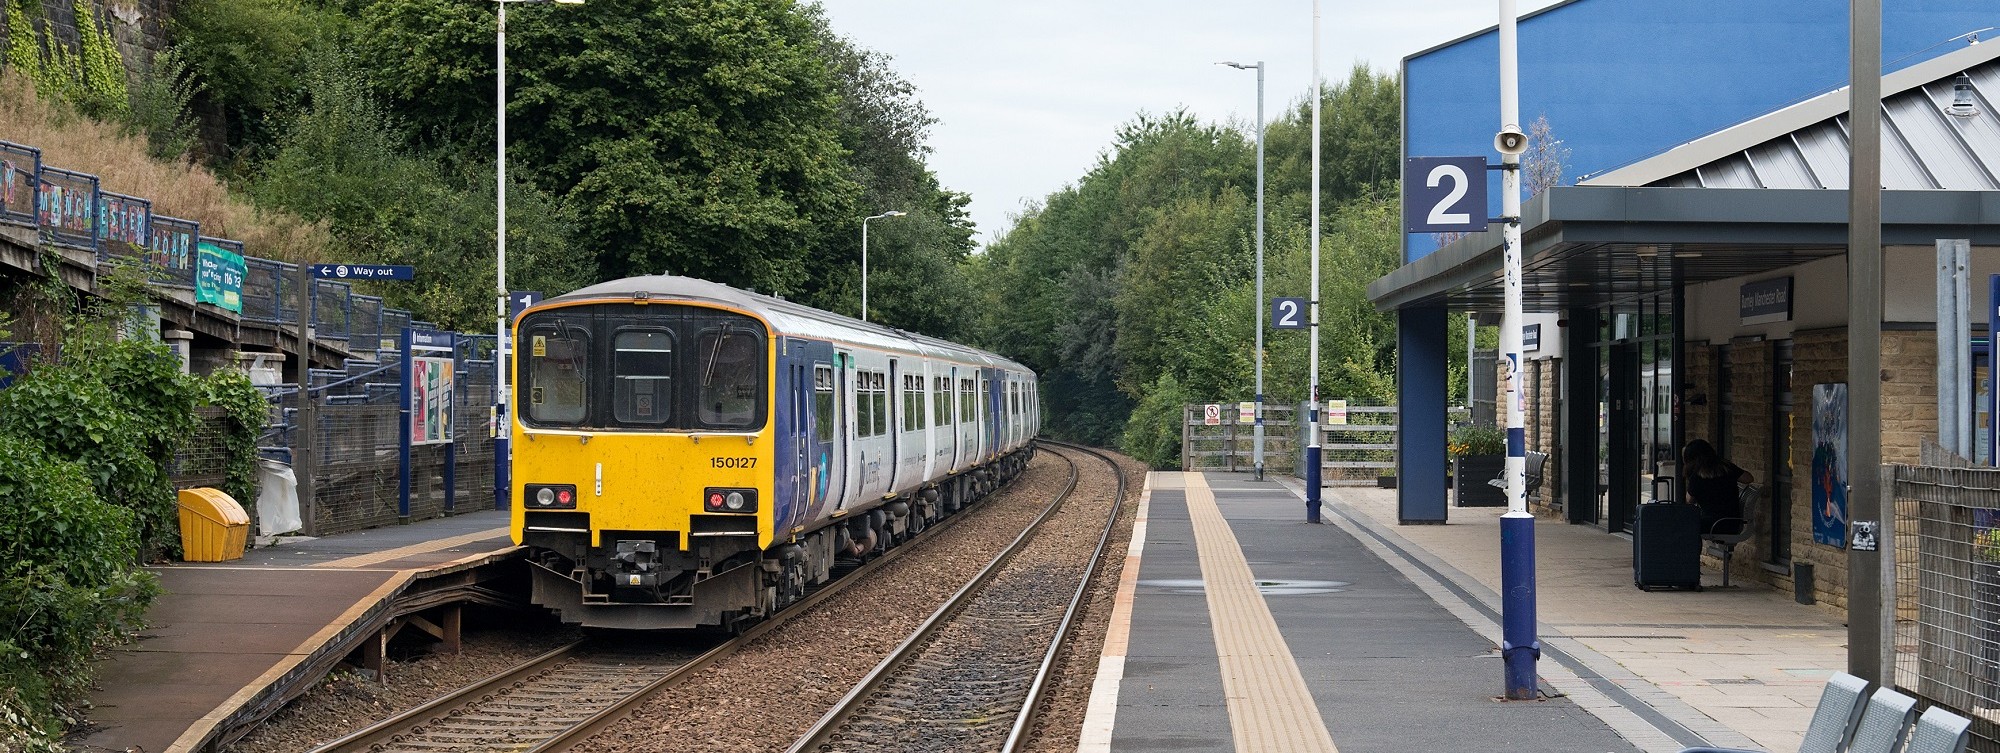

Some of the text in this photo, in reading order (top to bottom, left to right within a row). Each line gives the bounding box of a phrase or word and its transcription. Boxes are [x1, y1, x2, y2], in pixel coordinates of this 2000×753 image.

[1426, 164, 1470, 225] 2
[353, 266, 393, 277] Way out
[519, 294, 532, 309] 1
[1279, 300, 1298, 326] 2
[710, 457, 758, 469] 150127
